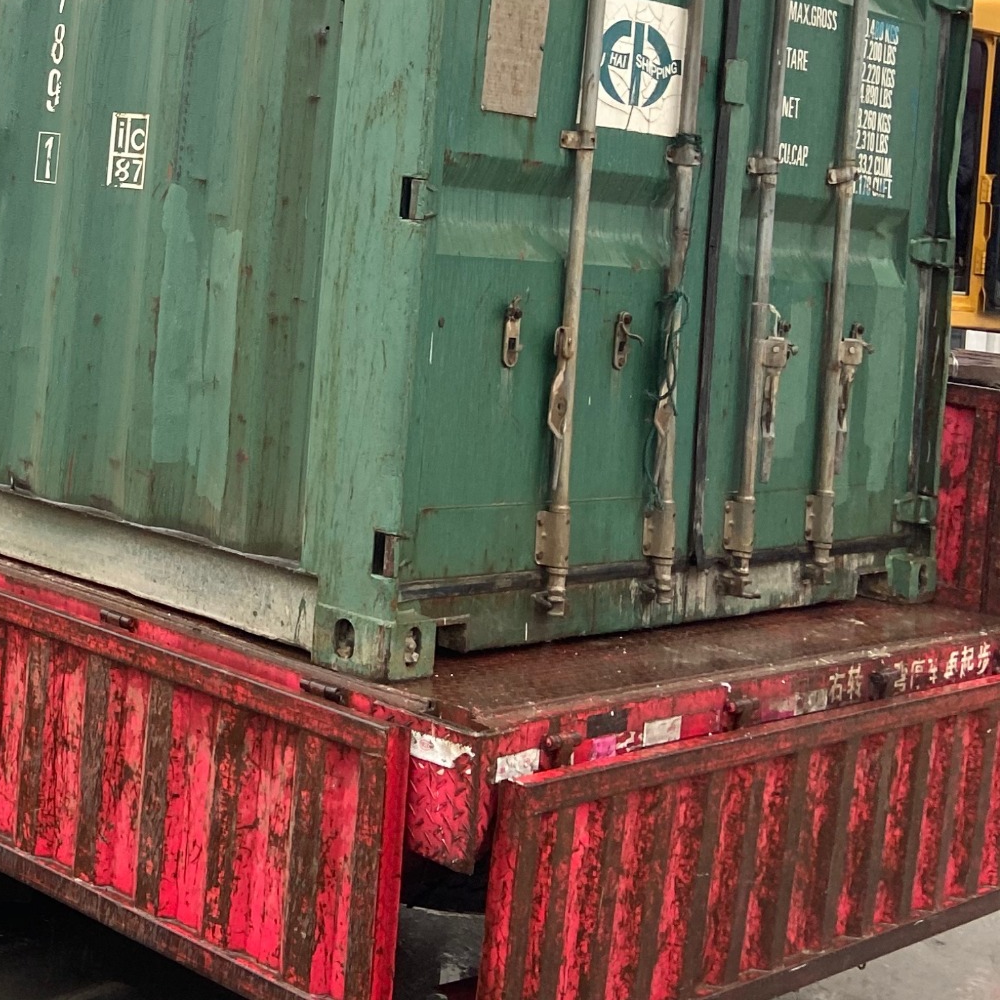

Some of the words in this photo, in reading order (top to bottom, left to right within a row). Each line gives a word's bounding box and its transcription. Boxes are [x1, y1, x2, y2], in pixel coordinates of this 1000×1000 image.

[883, 43, 897, 65] LBS
[609, 53, 628, 69] HAI
[635, 53, 678, 81] SHIPPING
[786, 47, 809, 71] TARE
[881, 66, 896, 88] KGS
[879, 88, 893, 109] LBS
[781, 96, 801, 119] NET
[877, 112, 892, 134] KGS
[875, 133, 889, 154] LBS
[114, 158, 143, 182] 87
